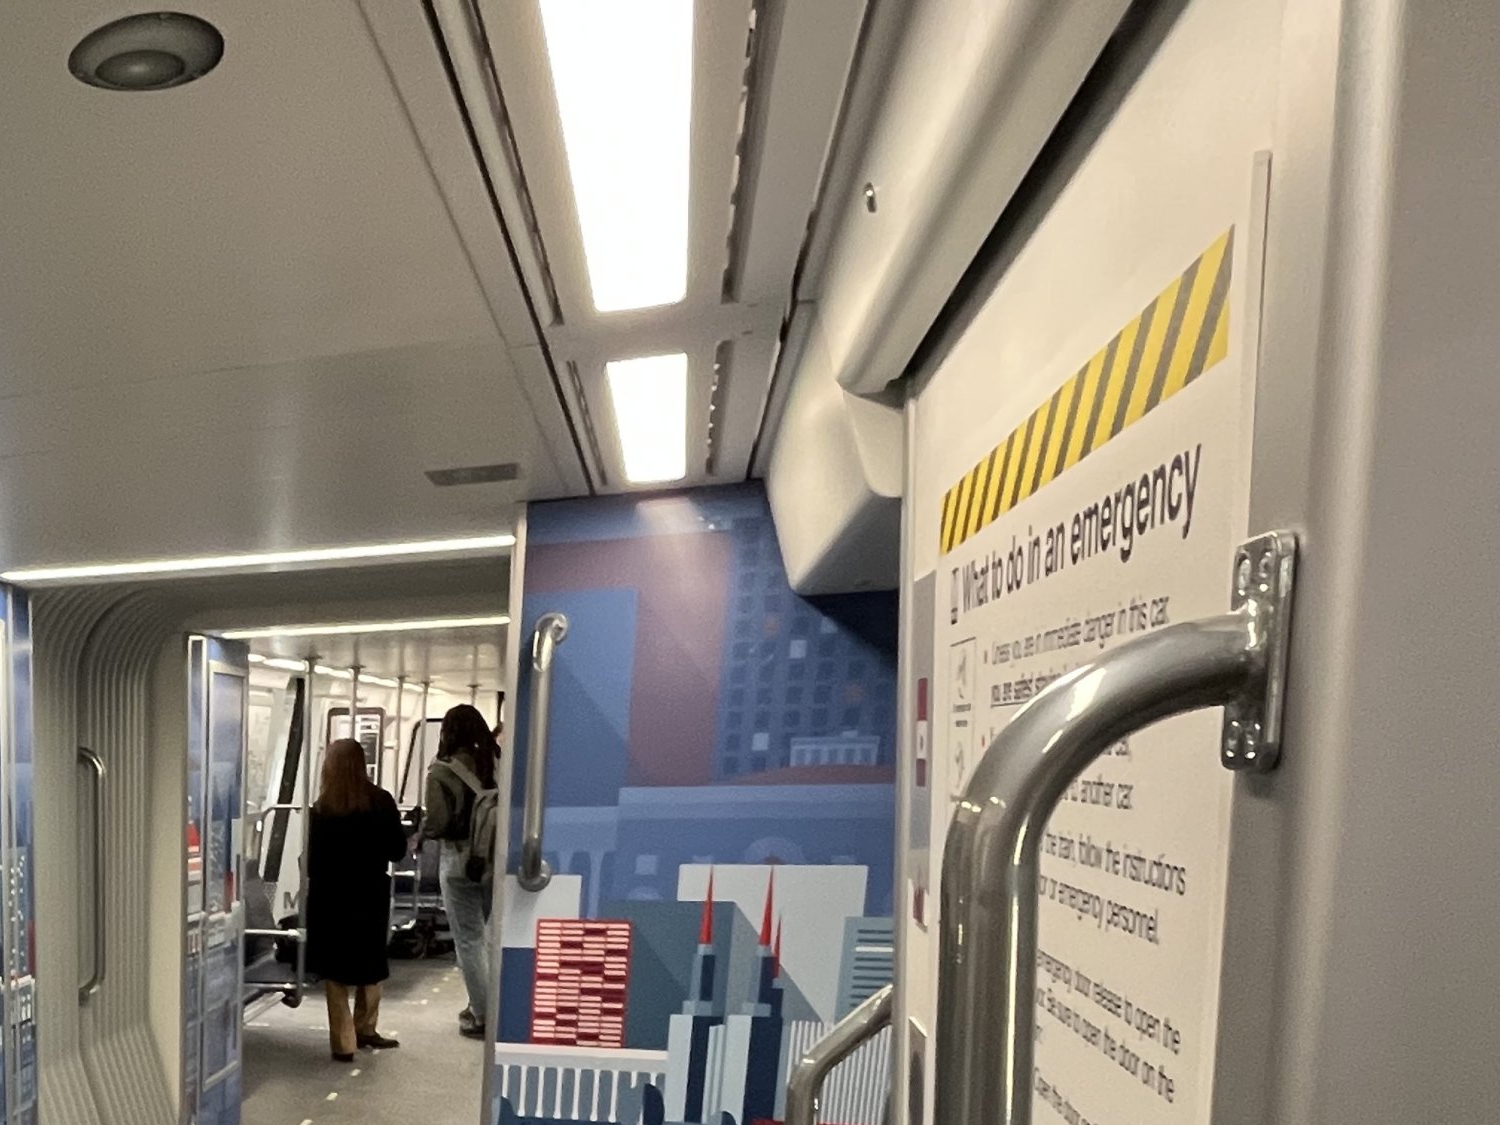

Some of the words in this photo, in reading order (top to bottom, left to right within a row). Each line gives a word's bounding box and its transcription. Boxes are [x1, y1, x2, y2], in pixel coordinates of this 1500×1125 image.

[1007, 535, 1024, 594] do
[1028, 525, 1040, 584] in
[1045, 522, 1065, 577] an
[1071, 443, 1202, 563] emergency
